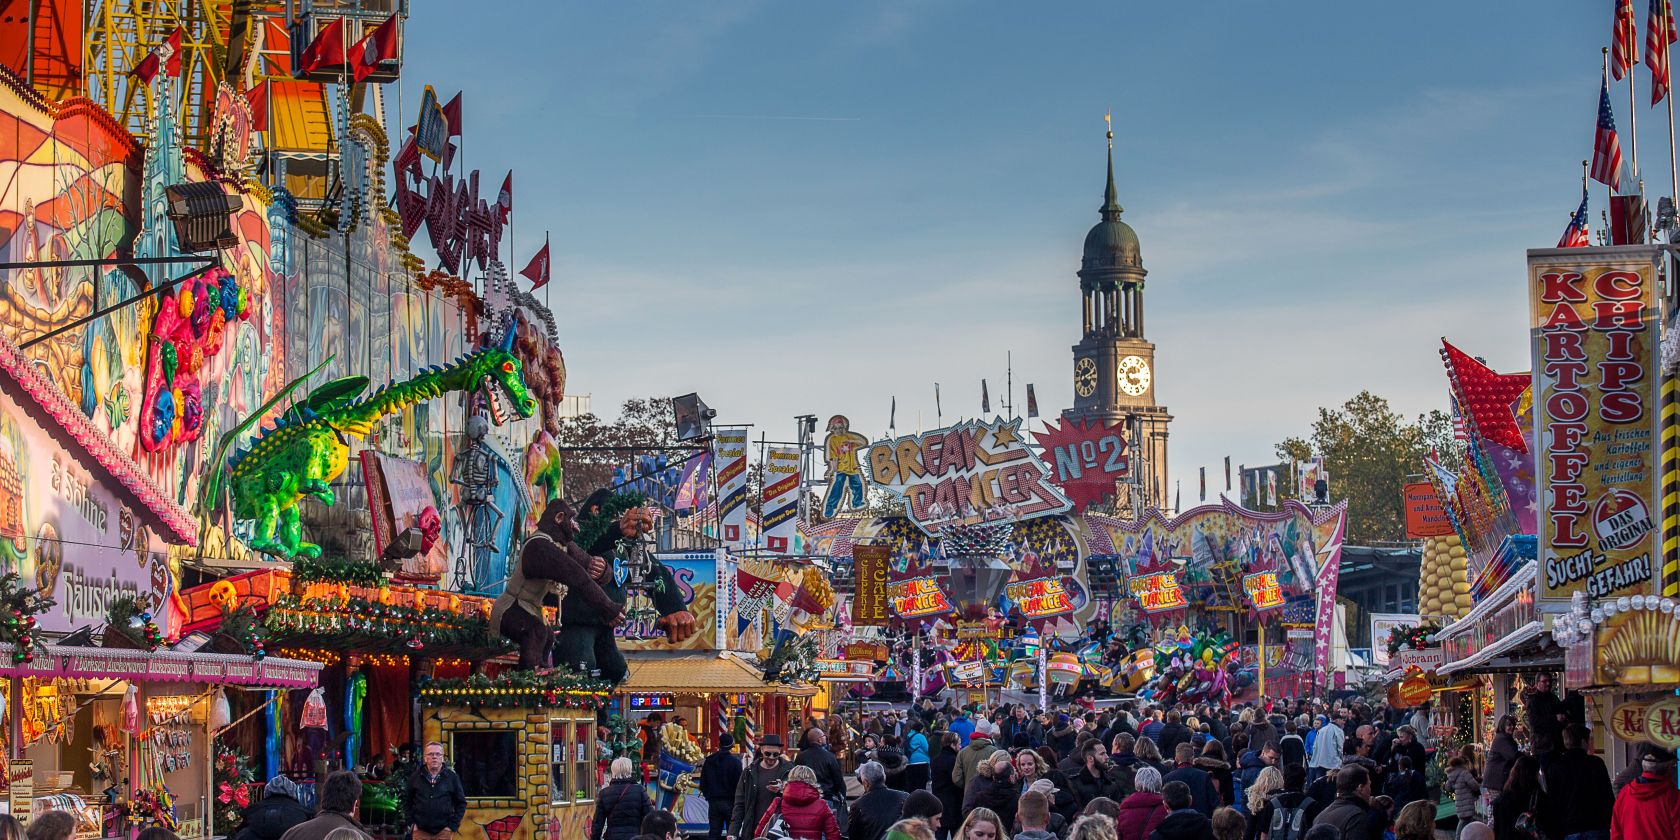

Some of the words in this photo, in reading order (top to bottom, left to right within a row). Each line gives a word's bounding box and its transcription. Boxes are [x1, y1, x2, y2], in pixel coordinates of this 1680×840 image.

[1591, 271, 1646, 422] CHIPS
[1540, 272, 1589, 547] KARTOFFEL
[717, 434, 745, 443] Pommes
[1593, 430, 1611, 444] Aus
[1614, 428, 1650, 443] frischen
[718, 448, 744, 459] Spezial
[769, 450, 799, 460] Pommes
[869, 427, 1030, 486] BREAK
[1606, 442, 1650, 455] Kartoffeln
[769, 463, 798, 474] Spezial
[1593, 460, 1610, 471] und
[1612, 459, 1641, 471] eigener
[903, 461, 1066, 523] DANCER
[64, 472, 107, 535] Söhne
[1607, 510, 1634, 531] DAS
[1598, 517, 1656, 552] ORIGINAL
[1546, 550, 1606, 588] SUCHT-
[1586, 553, 1651, 598] GEFAHR!
[1007, 579, 1063, 600] BREAK
[1129, 574, 1177, 593] BREAK
[1245, 574, 1278, 592] BREAK
[895, 593, 949, 615] DANCER
[1019, 593, 1074, 615] DANCER
[1141, 588, 1187, 607] DANCER
[1252, 587, 1285, 606] DANCER
[1403, 654, 1441, 665] Gebrann
[631, 697, 673, 707] SPEZIAL
